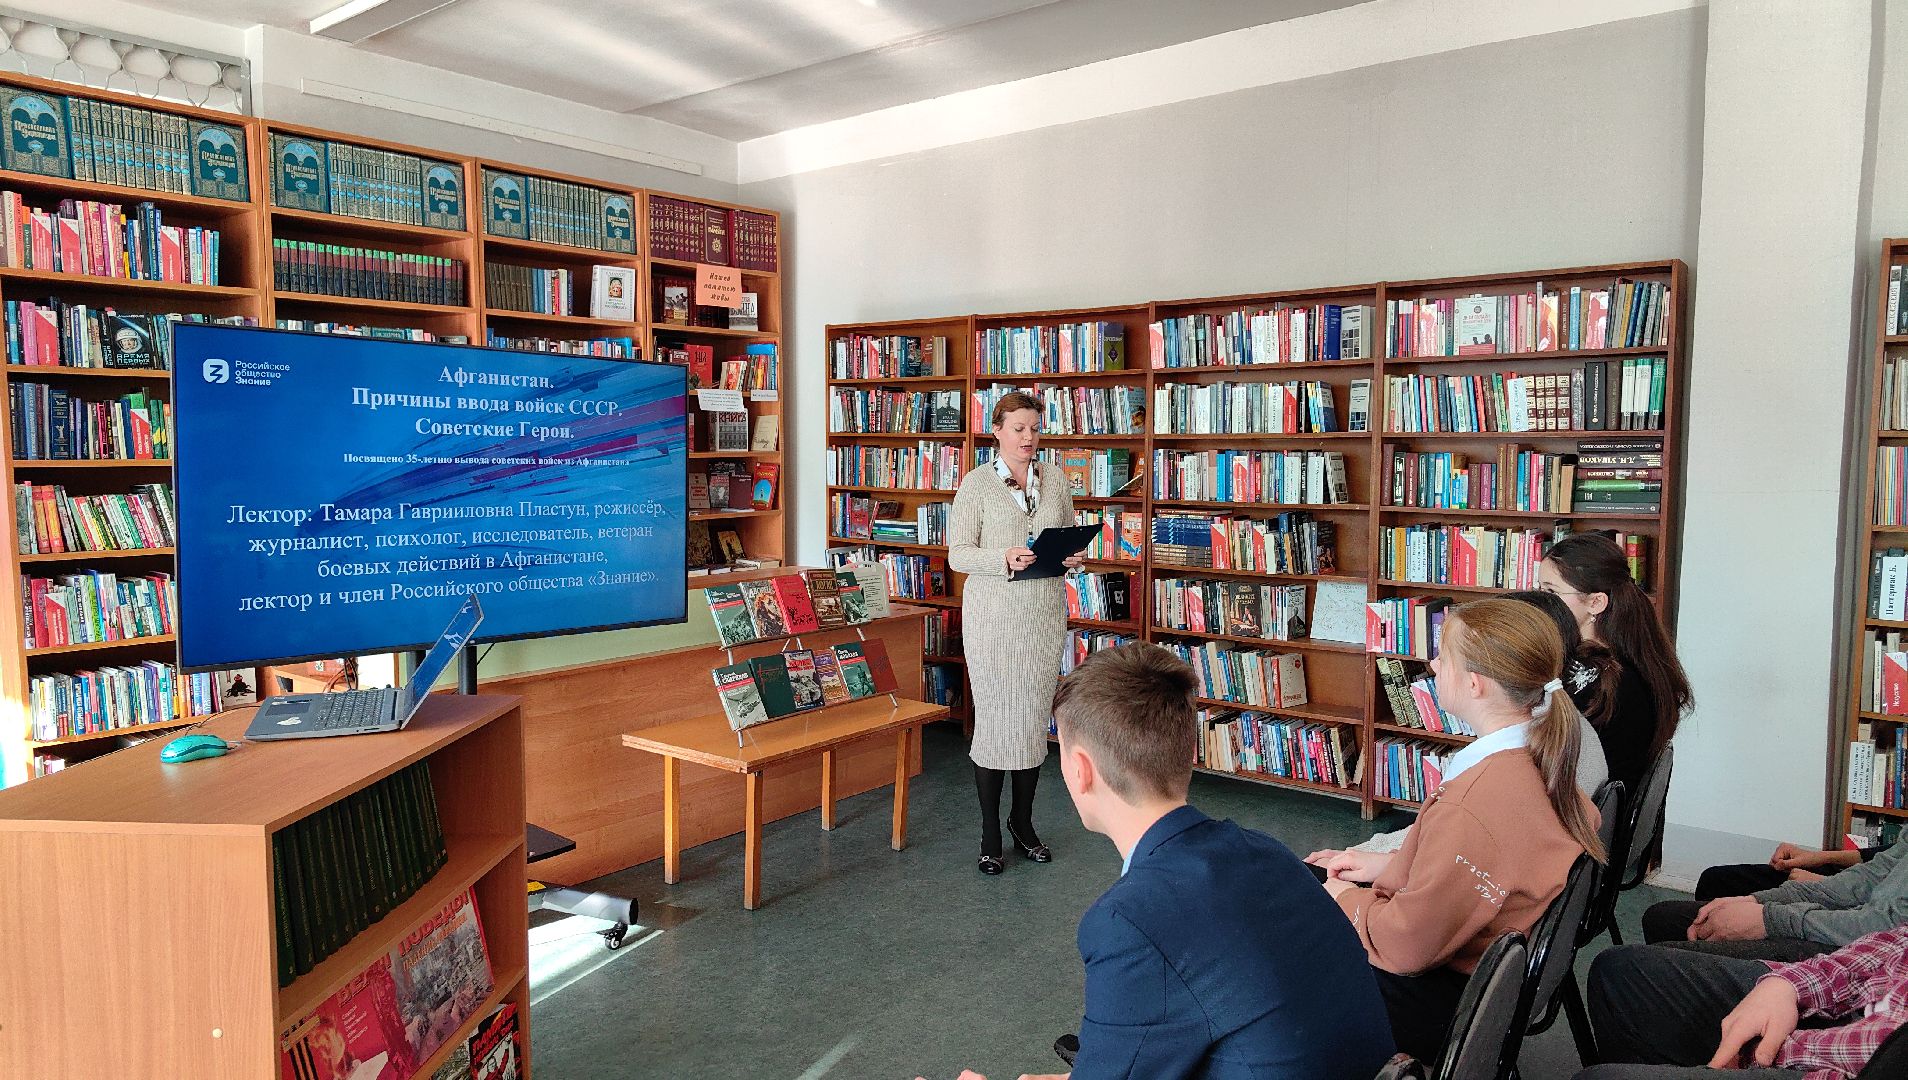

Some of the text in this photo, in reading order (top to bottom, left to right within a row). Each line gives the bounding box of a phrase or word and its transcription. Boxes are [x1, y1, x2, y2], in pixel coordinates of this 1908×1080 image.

[235, 360, 291, 371] Российское
[235, 369, 282, 378] общество
[235, 377, 272, 386] Знание
[438, 366, 555, 389] Афганистан.
[352, 388, 624, 417] Причины ввода войск СССР.
[416, 418, 574, 441] Советские Герои.
[718, 413, 747, 423] КНИГА
[343, 454, 630, 468] Посвящено 35-летию вывода советских войск из Афганистана
[227, 500, 665, 526] Лектор: Тамара Гаврииловна Пластун, режиссёр,
[249, 527, 652, 556] журналист, психолог, исследователь, ветеран
[318, 551, 607, 577] боевых действий в Афганистане,
[238, 570, 663, 612] лектор и член Российского общества «Знание».
